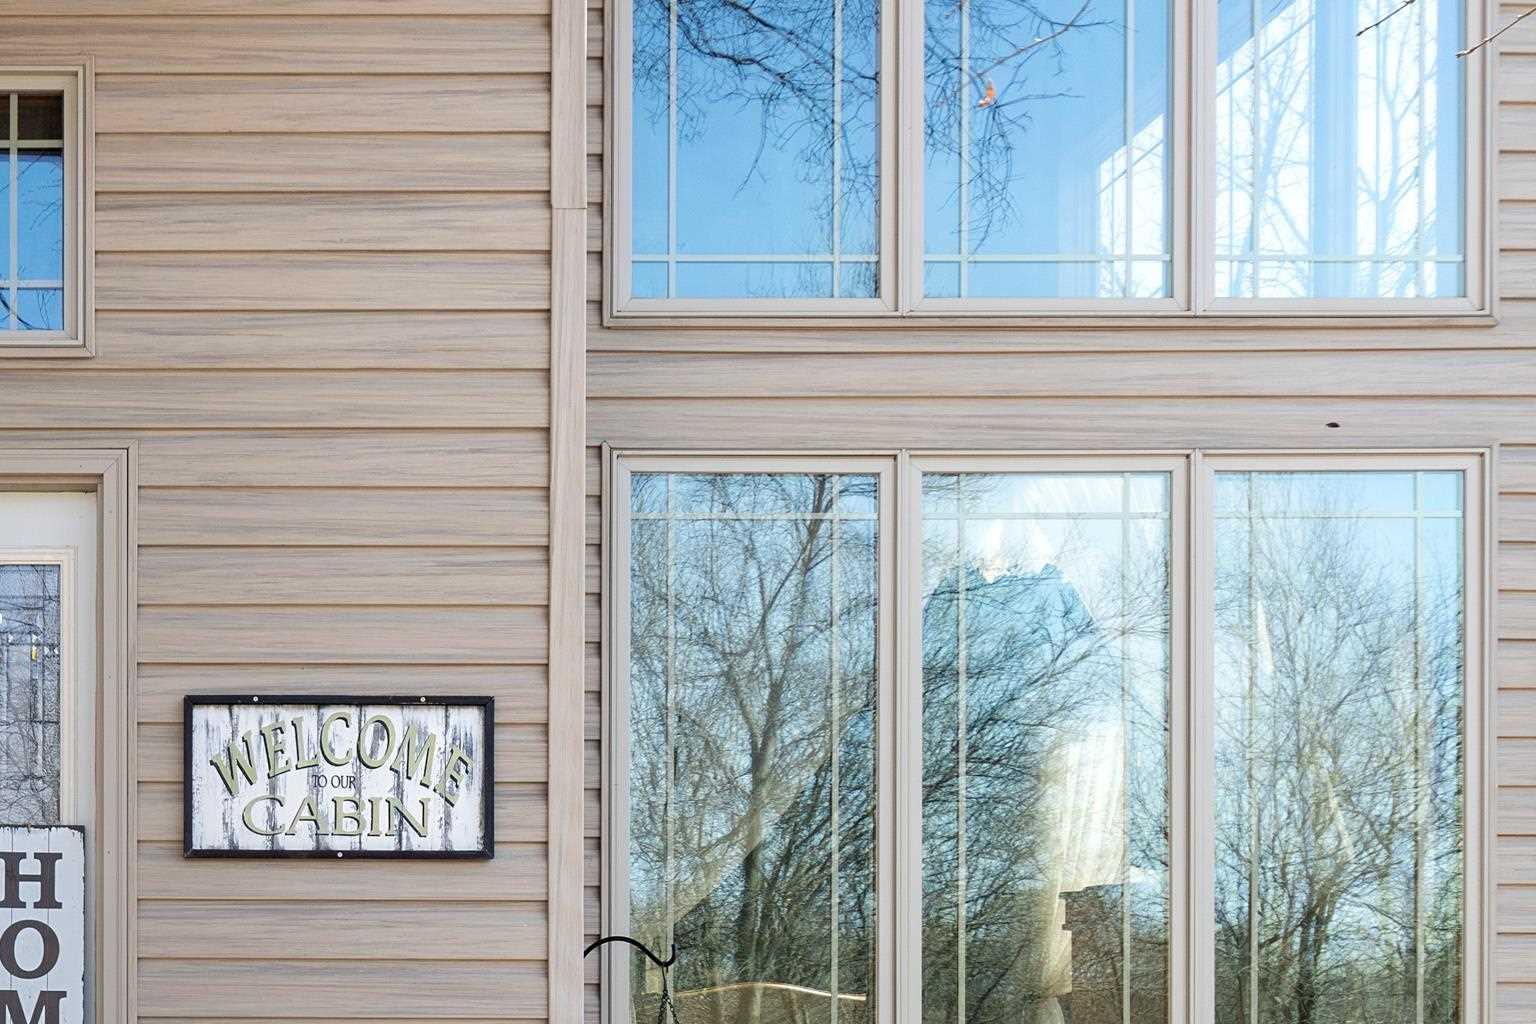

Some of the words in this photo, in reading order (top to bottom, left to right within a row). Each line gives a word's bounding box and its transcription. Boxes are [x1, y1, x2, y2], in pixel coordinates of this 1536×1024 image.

[209, 711, 475, 808] WELCOME
[312, 774, 328, 788] TO
[330, 774, 357, 789] OUR
[242, 795, 432, 838] CABIN
